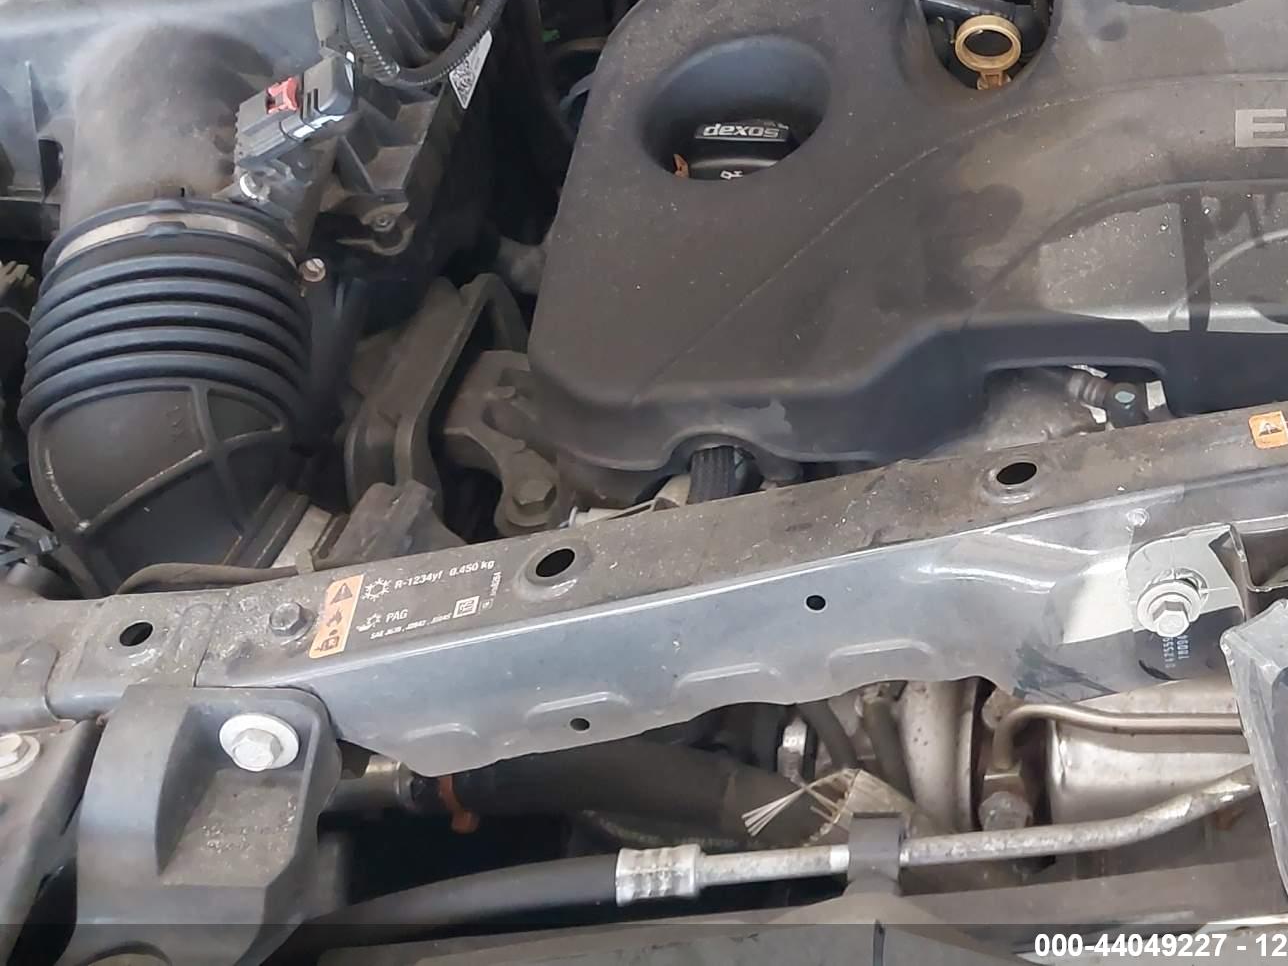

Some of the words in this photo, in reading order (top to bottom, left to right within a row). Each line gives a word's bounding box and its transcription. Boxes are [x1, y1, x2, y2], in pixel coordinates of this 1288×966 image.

[703, 122, 780, 138] dexos
[395, 571, 443, 589] R-1234yf
[449, 562, 479, 576] 0.450
[480, 560, 495, 570] kg
[385, 609, 409, 623] PAG
